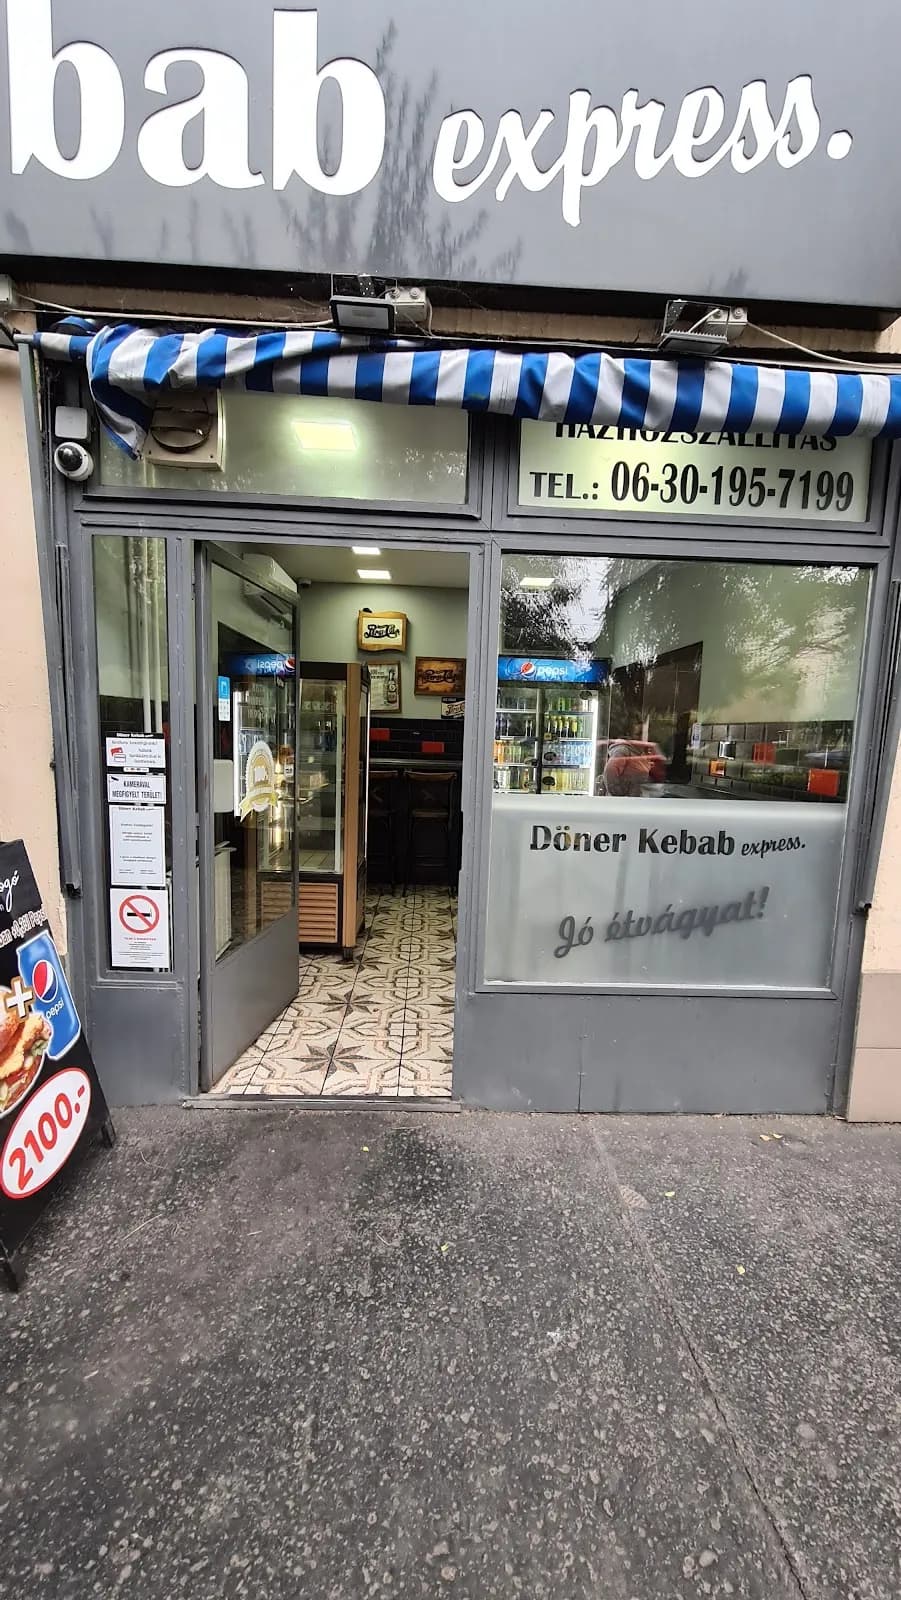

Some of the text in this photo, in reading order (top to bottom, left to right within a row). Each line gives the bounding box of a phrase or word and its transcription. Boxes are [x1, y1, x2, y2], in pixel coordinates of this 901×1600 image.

[6, 0, 854, 228] bab express.
[529, 460, 854, 512] TEL.: 06-30-195-7199
[536, 665, 569, 679] pepsi
[530, 825, 806, 858] Döner Kebab express.
[553, 886, 770, 959] Jó étvágyat!
[45, 997, 64, 1021] pepsi
[9, 1085, 86, 1191] 2100.-
